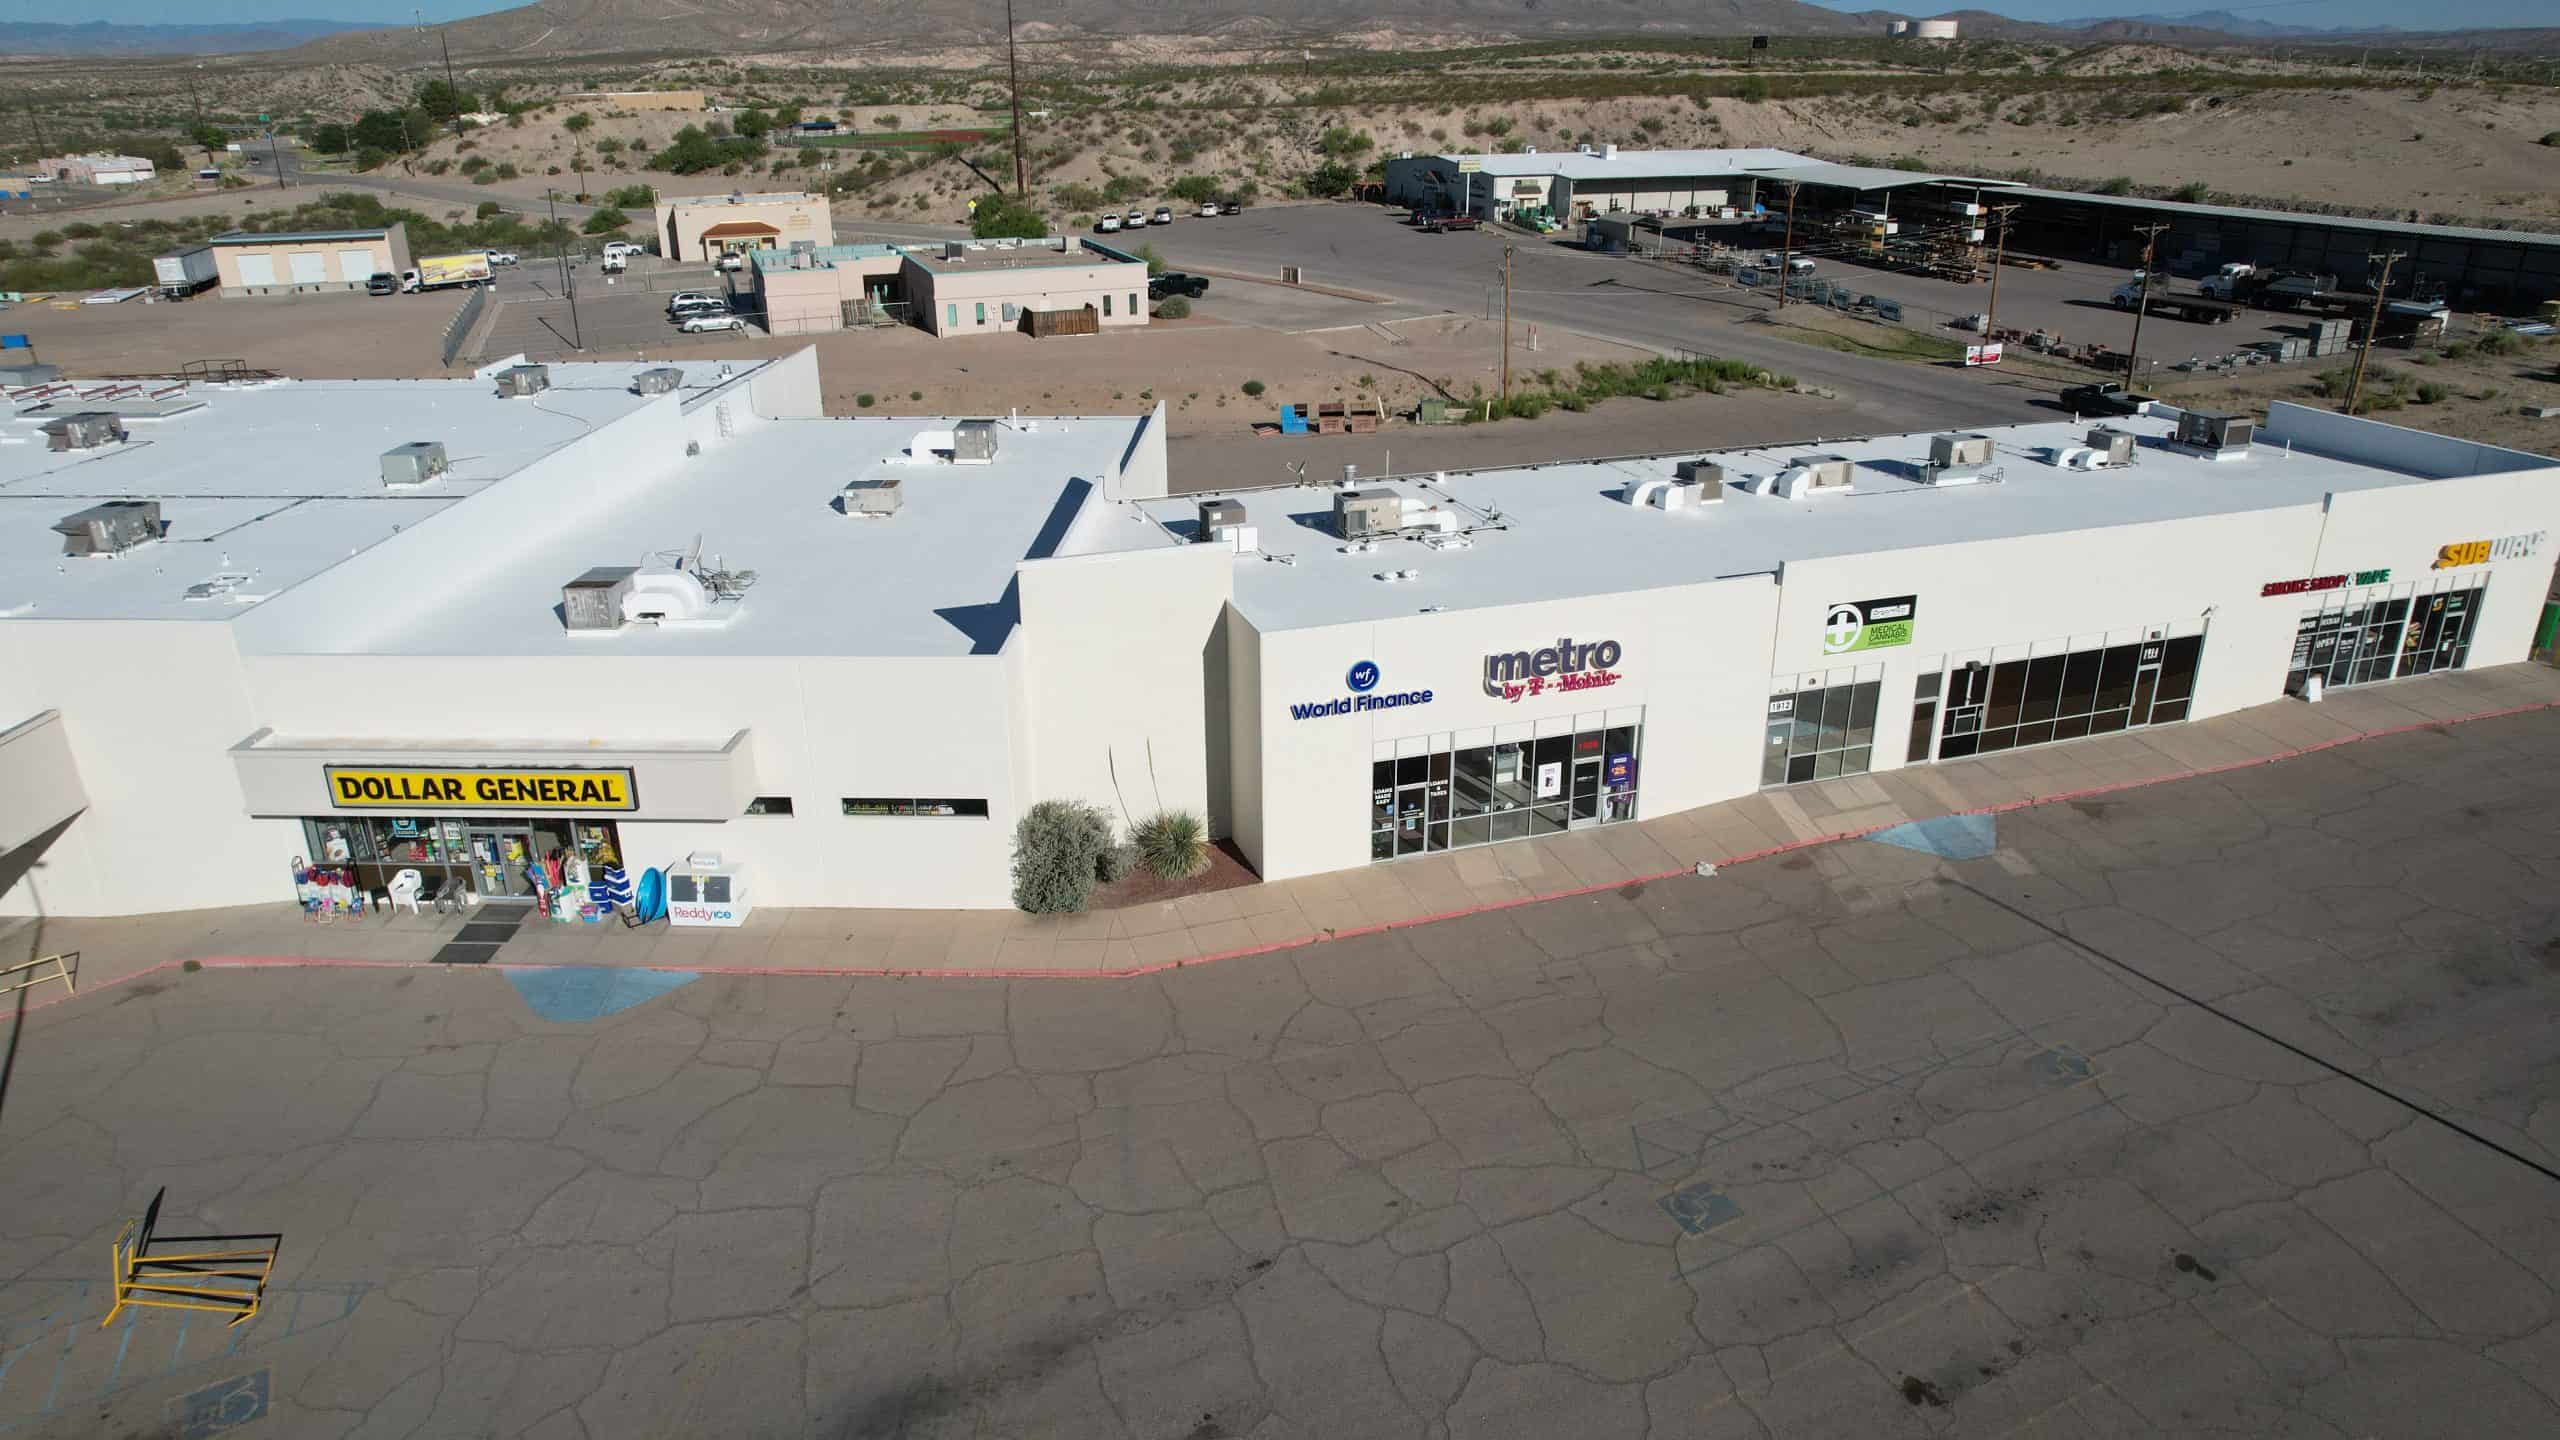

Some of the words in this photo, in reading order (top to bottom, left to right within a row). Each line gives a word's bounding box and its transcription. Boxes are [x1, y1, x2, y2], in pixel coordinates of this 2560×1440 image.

[2431, 530, 2546, 570] SUBWAY
[2261, 579, 2312, 597] SMOKE
[2311, 574, 2346, 592] SHOP
[2356, 569, 2391, 586] VAPE
[1871, 623, 1905, 636] MEDICAL
[1355, 667, 1372, 681] wf
[1485, 638, 1622, 686] metro
[1291, 697, 1351, 720] World
[1354, 690, 1433, 712] Finance
[1503, 682, 1525, 703] by
[337, 777, 465, 800] DOLLAR
[475, 778, 621, 802] GENERAL
